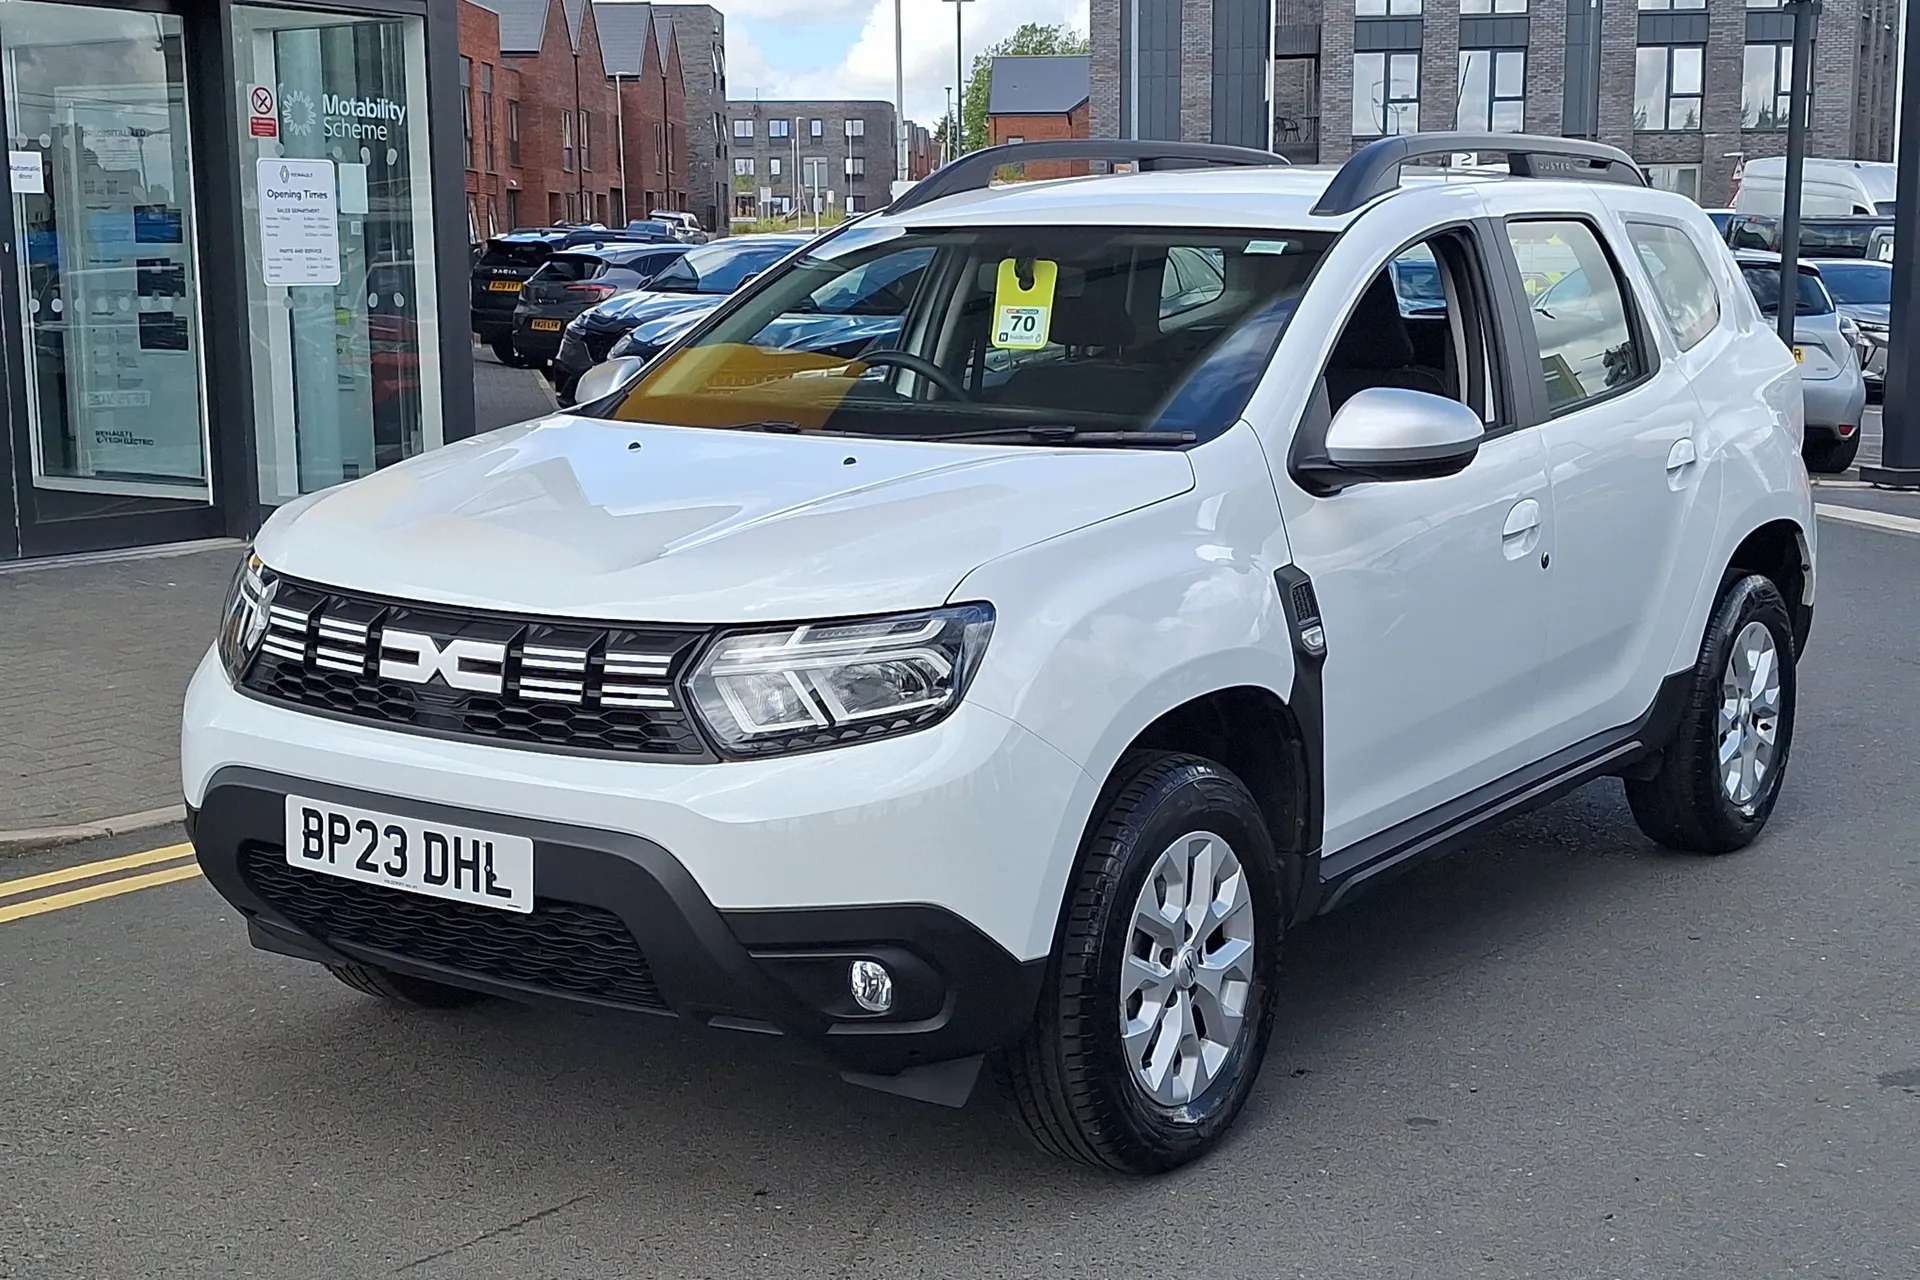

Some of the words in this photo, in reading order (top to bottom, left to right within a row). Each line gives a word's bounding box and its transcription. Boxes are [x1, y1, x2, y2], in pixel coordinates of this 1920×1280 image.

[322, 93, 406, 126] Motability
[323, 116, 388, 141] Scheme
[266, 188, 302, 201] Opening
[303, 189, 329, 200] Times
[1010, 315, 1036, 332] 70
[301, 806, 408, 878] BP23
[423, 830, 512, 899] DHL
